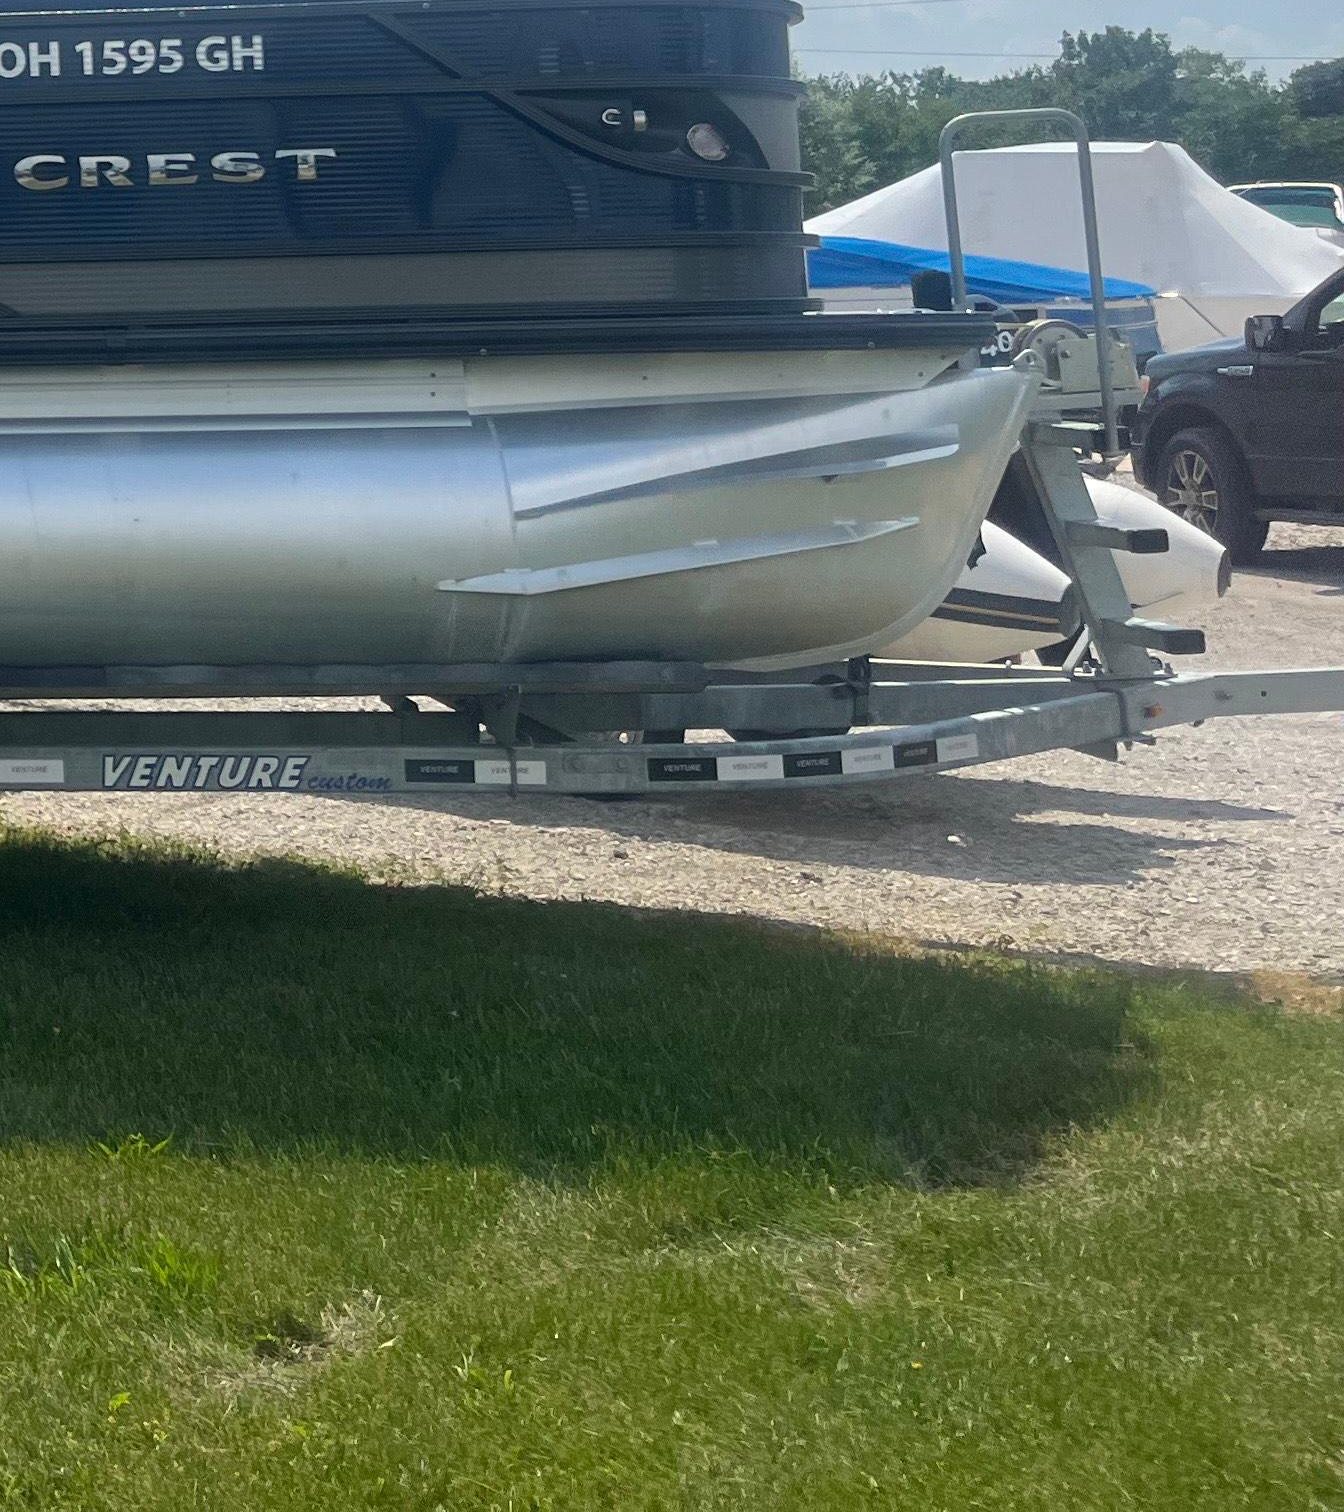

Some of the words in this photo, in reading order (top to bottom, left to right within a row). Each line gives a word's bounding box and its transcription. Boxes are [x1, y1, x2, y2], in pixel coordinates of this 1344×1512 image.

[74, 39, 184, 76] 1595
[195, 35, 264, 72] GH
[14, 147, 337, 190] CREST
[663, 763, 702, 772] VENTURE
[732, 760, 768, 771] VENTURE
[796, 757, 831, 768] VENTURE
[102, 754, 312, 790] VENTURE
[308, 773, 394, 790] custom
[419, 764, 459, 774] VENTURE
[490, 766, 529, 775] VENTRE
